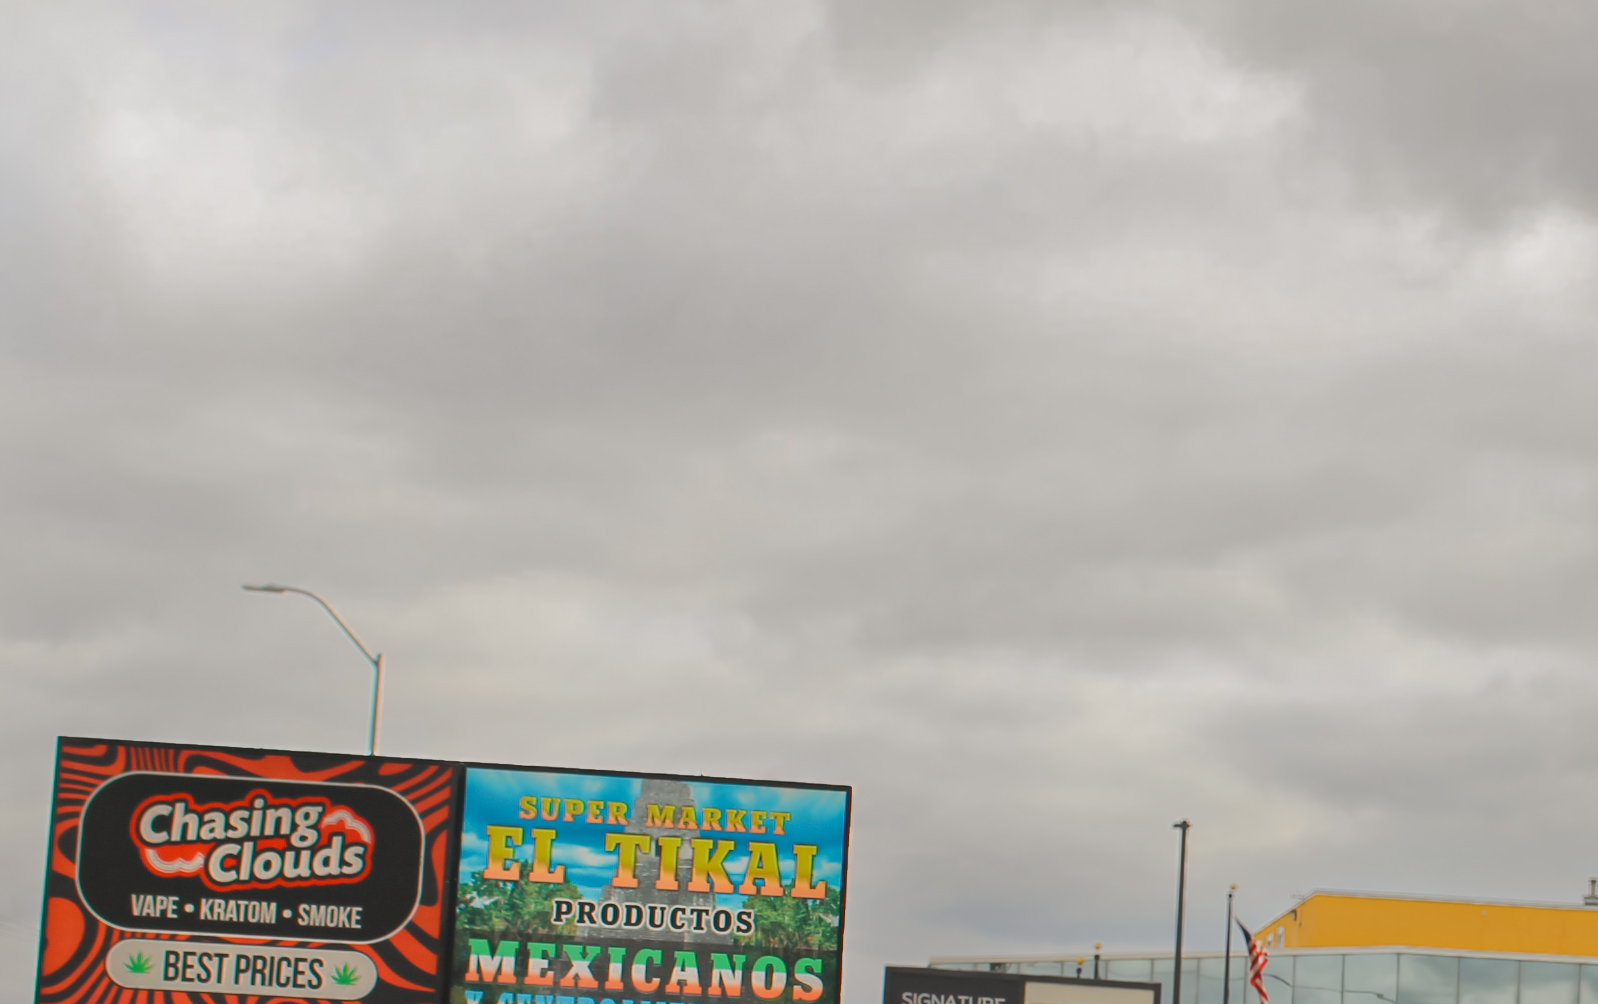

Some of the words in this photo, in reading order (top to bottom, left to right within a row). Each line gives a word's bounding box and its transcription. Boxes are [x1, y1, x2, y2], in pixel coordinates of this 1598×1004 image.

[138, 797, 324, 848] Chasing
[518, 795, 630, 827] SUPER
[645, 803, 792, 836] MARKET
[207, 835, 366, 884] Clouds
[482, 824, 566, 885] EL
[604, 832, 828, 900] TIKAL
[130, 893, 180, 920] VAPE
[199, 897, 277, 925] KRATOM
[296, 903, 363, 930] SMOKE
[552, 899, 755, 935] PRODUCTOS
[162, 949, 230, 986] BEST
[233, 952, 325, 991] PRICES
[464, 937, 825, 1003] MEXICANOS
